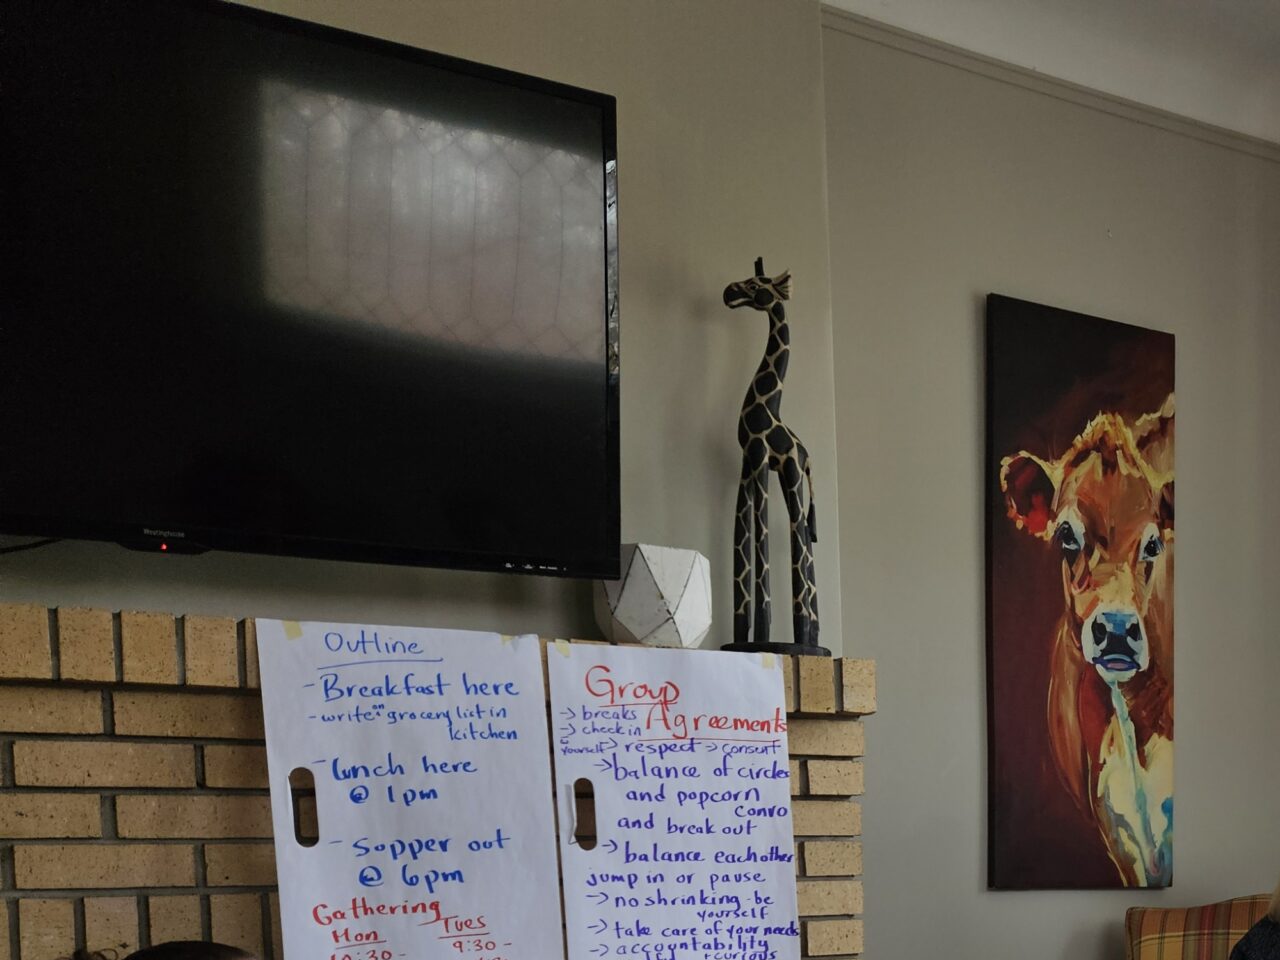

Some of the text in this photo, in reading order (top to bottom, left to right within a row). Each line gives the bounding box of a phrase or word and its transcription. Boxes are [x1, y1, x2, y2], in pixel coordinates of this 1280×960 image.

[324, 630, 424, 655] Outline
[320, 673, 520, 702] Breakfast here
[585, 665, 680, 711] Group
[321, 707, 373, 723] write
[489, 707, 507, 718] in
[582, 705, 638, 721] breaks
[646, 701, 787, 740] Agreements
[448, 726, 518, 741] kitchen
[624, 738, 702, 760] respect
[422, 756, 478, 773] here
[612, 753, 701, 781] balance
[713, 753, 733, 777] of
[626, 784, 760, 810] and popcorn
[618, 813, 758, 835] and break out
[468, 828, 511, 851] out
[624, 841, 705, 864] balance
[646, 871, 664, 884] in
[676, 873, 695, 884] or
[710, 873, 766, 890] pause
[645, 888, 740, 910] shrinking
[754, 890, 775, 905] be
[312, 897, 442, 926] Gathering
[697, 906, 769, 922] yourself
[440, 915, 487, 932] Tues
[615, 920, 800, 939] take care of your needs
[616, 936, 769, 956] accountability
